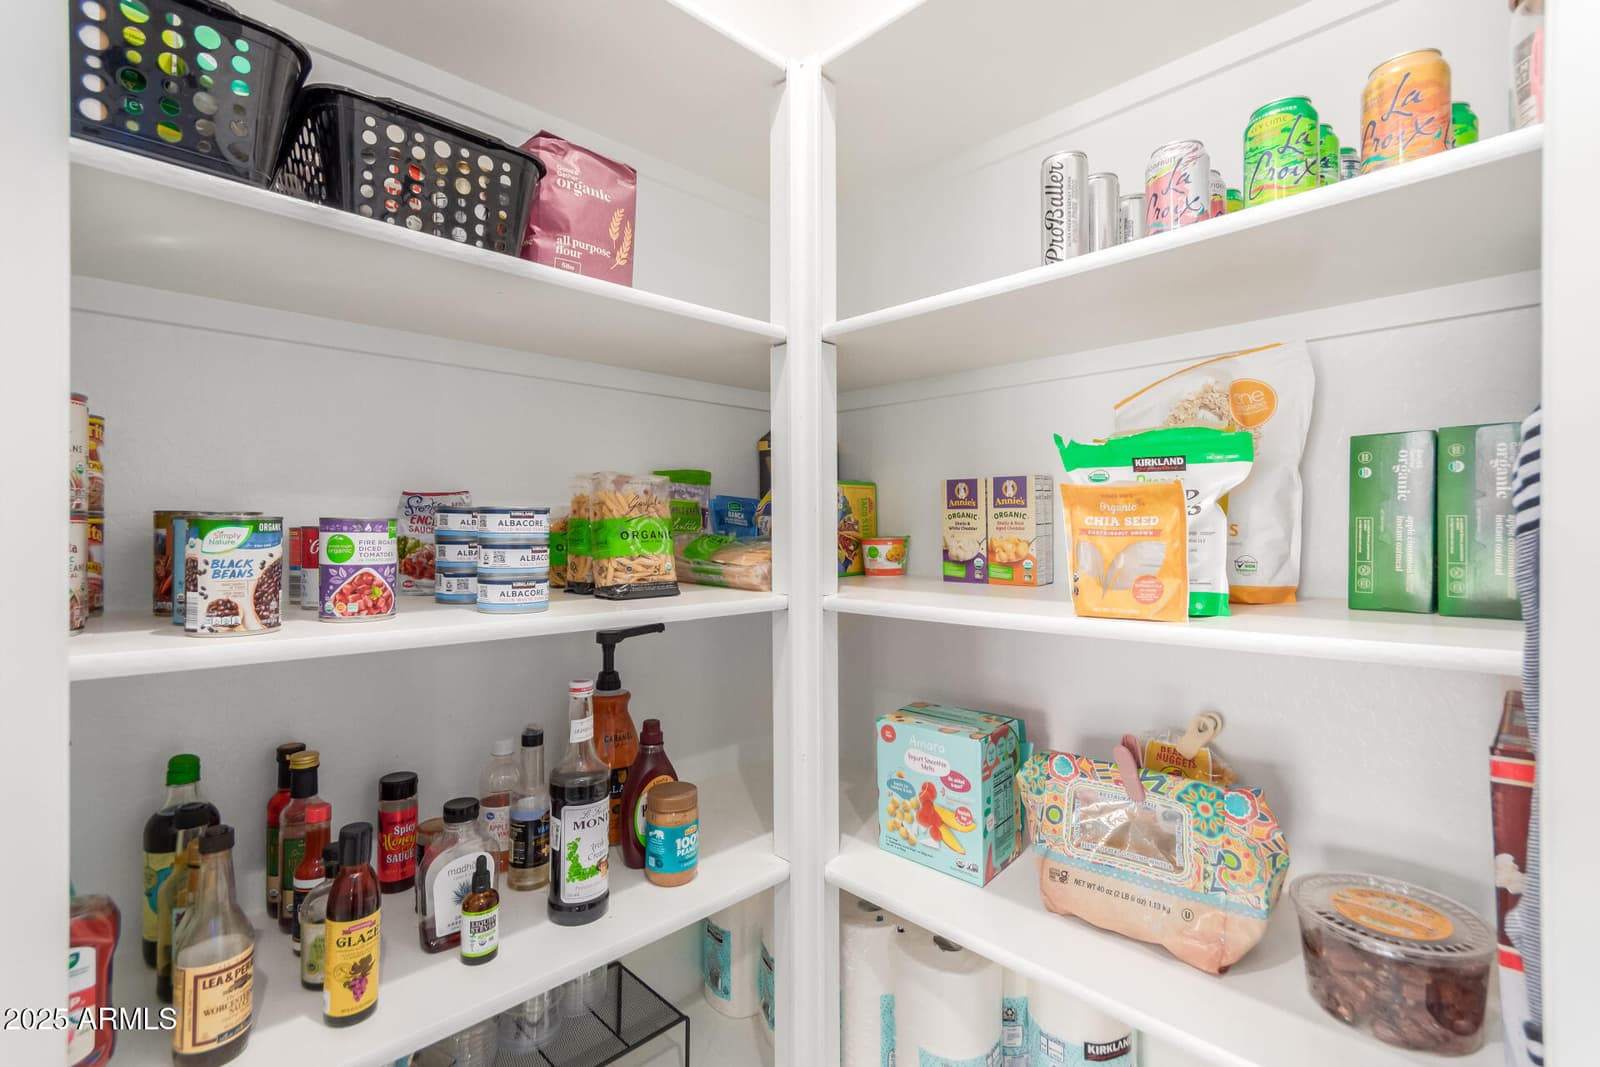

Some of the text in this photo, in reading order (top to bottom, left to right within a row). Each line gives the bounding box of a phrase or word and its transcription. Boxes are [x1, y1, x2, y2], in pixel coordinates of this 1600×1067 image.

[1381, 72, 1424, 122] La
[1277, 114, 1312, 155] La
[1161, 158, 1193, 195] La
[1249, 150, 1317, 200] Croix
[556, 177, 612, 202] organic
[1044, 161, 1065, 265] ProBaller
[556, 235, 611, 258] all purpose
[556, 245, 582, 259] flour
[1134, 456, 1185, 467] KIRKLAND
[1392, 449, 1411, 501] organic
[1489, 442, 1511, 499] organic
[949, 498, 976, 507] Annie's
[995, 497, 1025, 506] Annie's
[1099, 500, 1137, 515] Organic
[727, 511, 745, 519] RANCH
[947, 511, 978, 520] ORGANIC
[994, 511, 1027, 520] ORGANIC
[1084, 515, 1160, 527] CHIA SEED
[214, 531, 241, 540] Simply
[620, 530, 673, 541] ORGANIC
[210, 559, 254, 568] BLACK
[211, 569, 254, 579] BEANS
[499, 588, 544, 597] ALBACORE
[909, 735, 945, 753] Amara
[1160, 745, 1181, 757] BEA
[907, 752, 947, 768] Yogurt Smoothie
[1155, 752, 1198, 769] NUGGETS
[921, 763, 935, 773] Melts
[393, 823, 417, 836] Spicy
[382, 833, 417, 851] Honey
[676, 833, 698, 850] 100
[386, 849, 415, 864] SAUCE
[1073, 878, 1085, 887] NET
[1086, 882, 1096, 890] WT
[1096, 885, 1105, 893] 40
[1113, 889, 1121, 898] (2
[1121, 892, 1130, 900] LB
[1136, 898, 1147, 906] oz)
[336, 926, 380, 949] GLAZE
[202, 976, 224, 990] LEA
[225, 971, 233, 983] &
[1087, 1038, 1129, 1055] KIRKLAN
